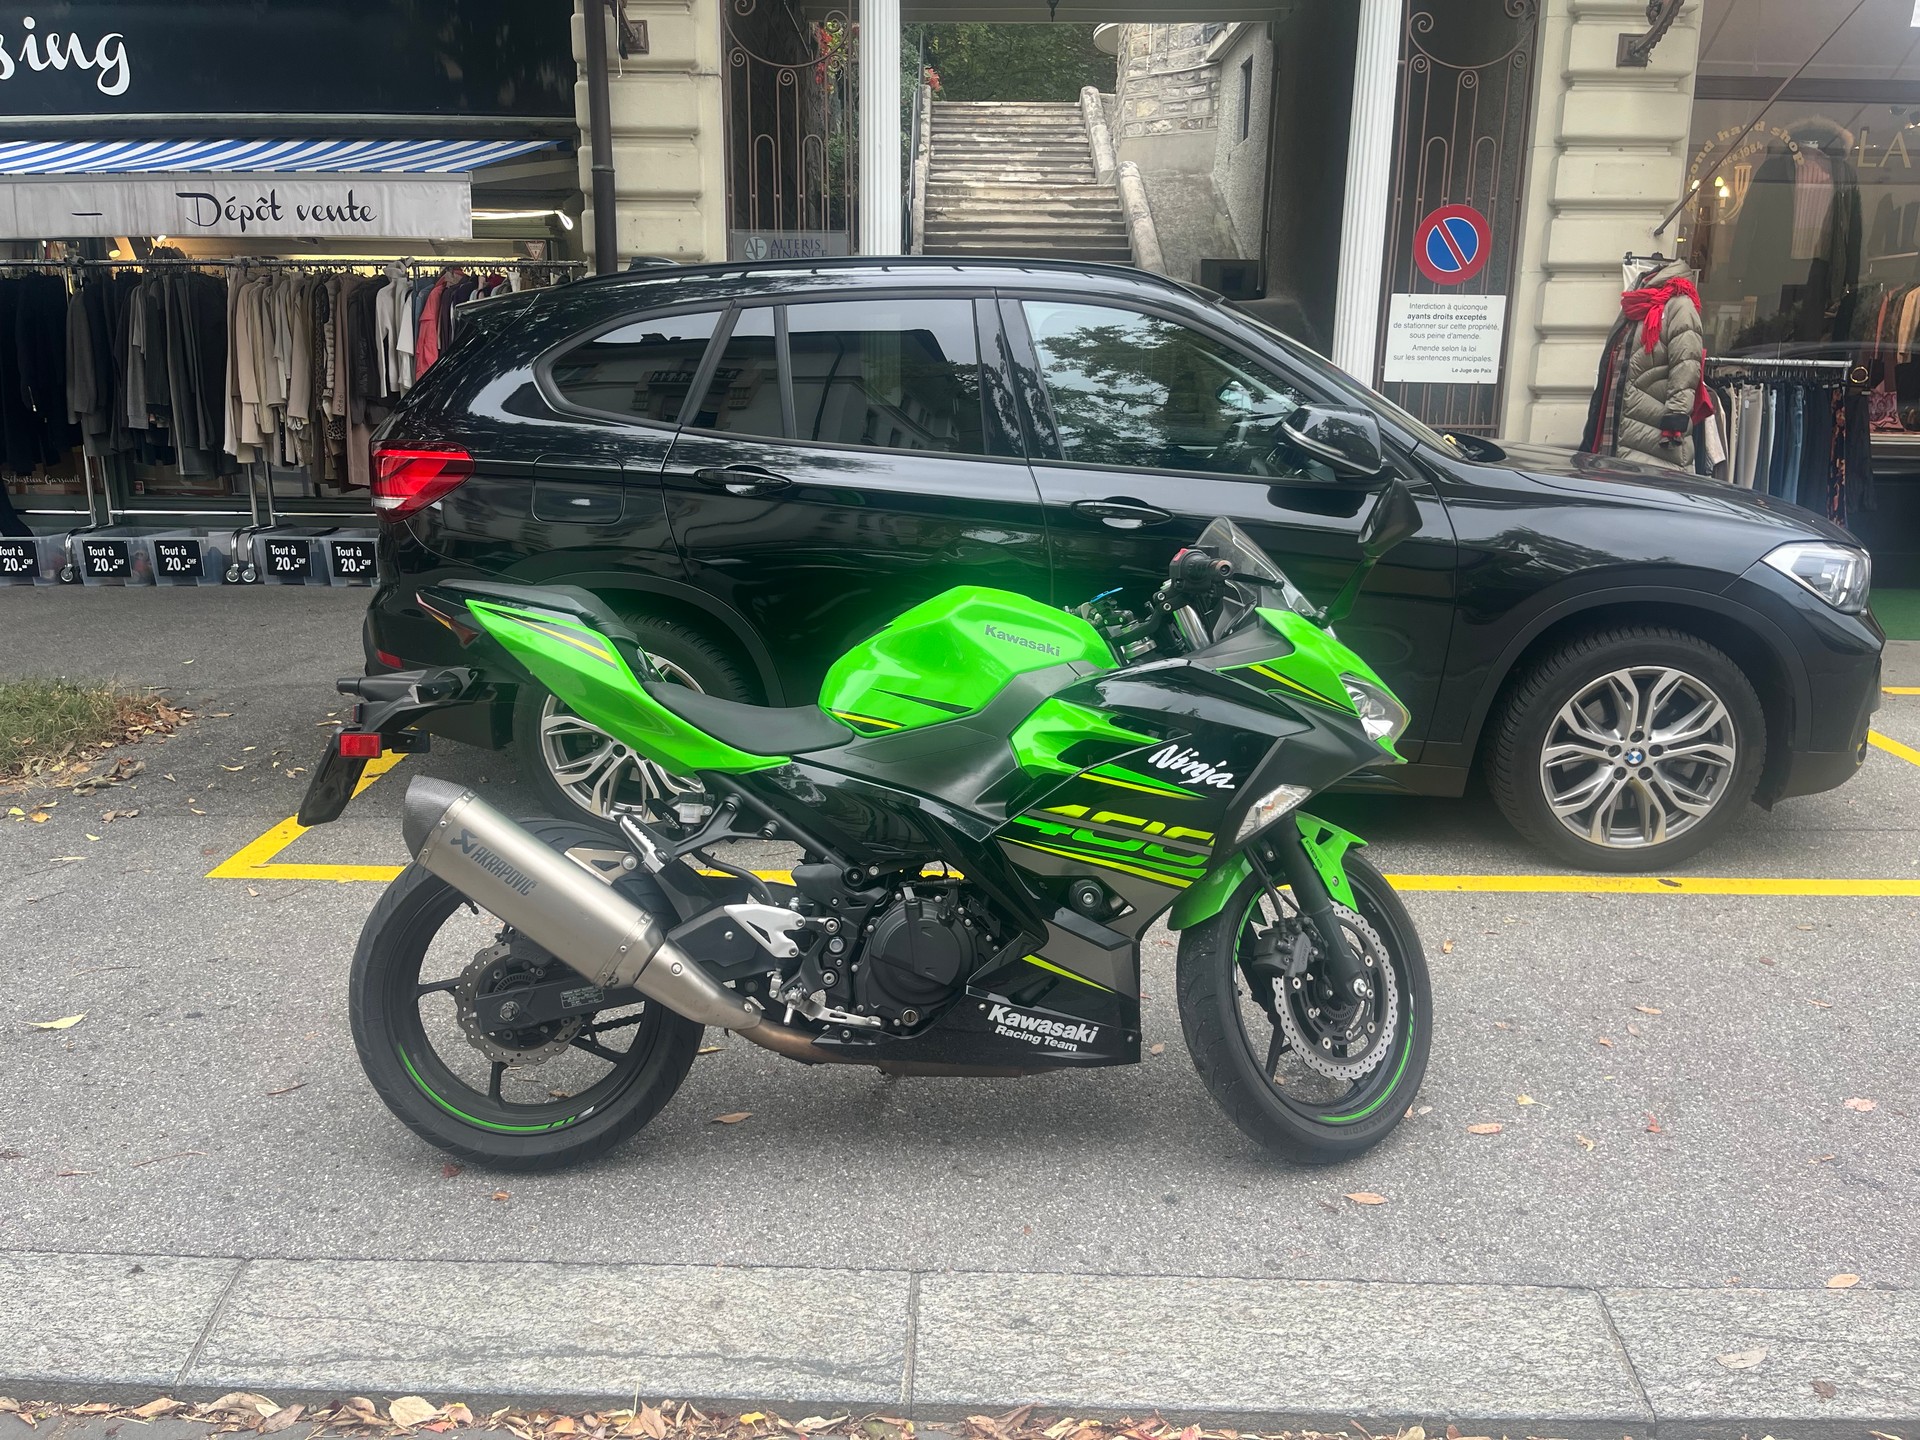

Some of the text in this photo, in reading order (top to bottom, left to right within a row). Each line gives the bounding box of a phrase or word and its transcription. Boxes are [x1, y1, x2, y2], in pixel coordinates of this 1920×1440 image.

[1741, 141, 1763, 158] 1984
[1770, 126, 1805, 166] shop
[1857, 129, 1912, 169] LA
[175, 188, 284, 233] Dépôt
[296, 189, 378, 222] vente
[770, 239, 821, 249] ALTERIS
[770, 249, 828, 259] FINANCE
[1407, 313, 1431, 321] ayants
[1468, 323, 1500, 331] propriété,
[1452, 355, 1492, 363] municipales.
[0, 545, 24, 556] Tout à
[87, 546, 114, 557] Tout à
[160, 545, 187, 556] Tout à
[270, 545, 296, 556] Tout à
[336, 546, 362, 557] Tout à
[984, 624, 1061, 657] Kawasaki
[1147, 744, 1236, 789] Ninja
[1012, 804, 1216, 867] 400
[987, 1004, 1100, 1044] Kawasaki
[994, 1025, 1078, 1052] Racing Team
